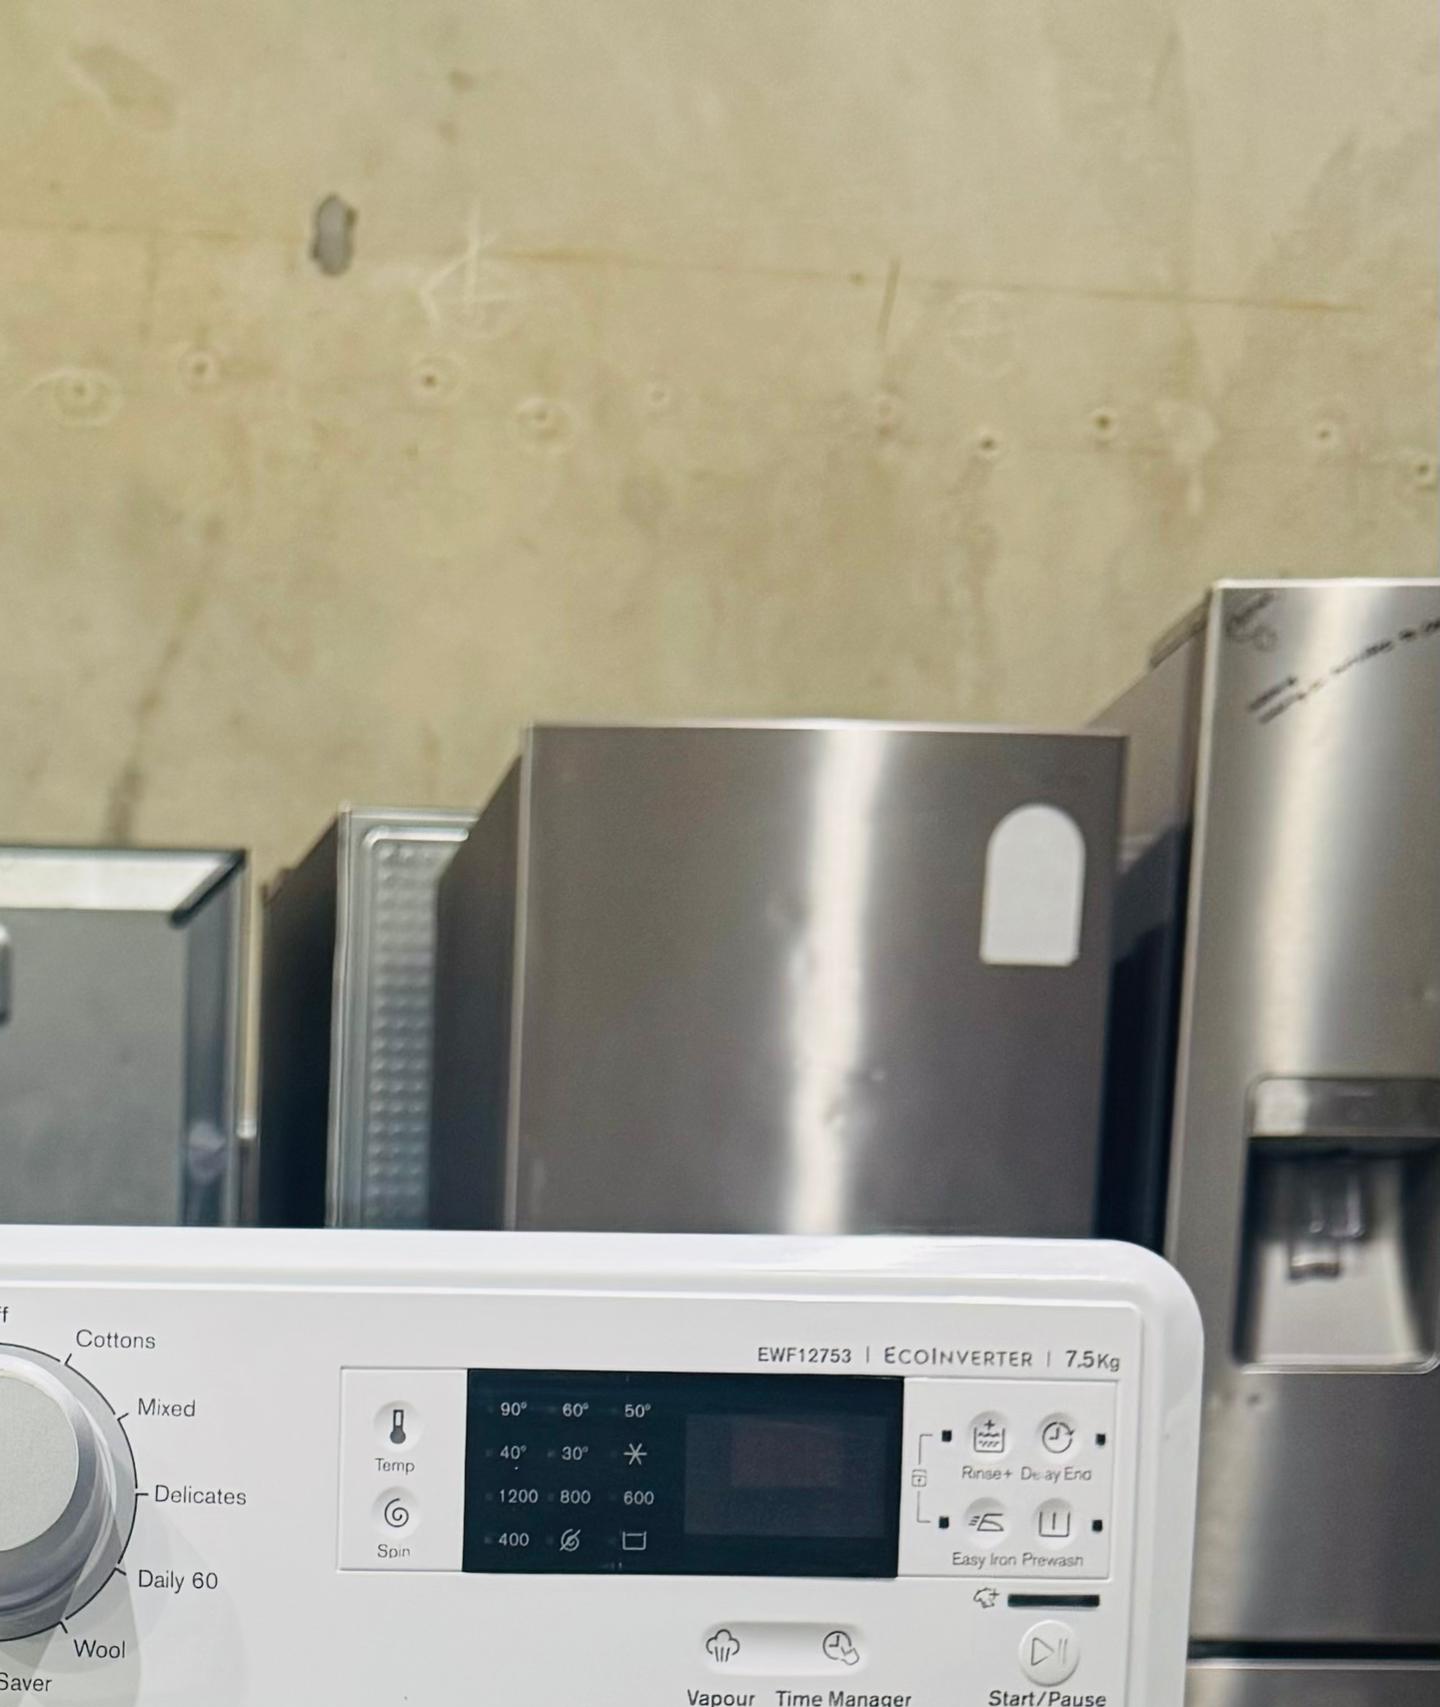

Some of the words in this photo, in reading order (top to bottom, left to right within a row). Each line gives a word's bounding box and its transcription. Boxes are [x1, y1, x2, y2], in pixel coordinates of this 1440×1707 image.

[75, 1329, 157, 1350] Cottons
[757, 1346, 852, 1364] EWF12753
[137, 1398, 197, 1418] Mixed
[375, 1458, 415, 1475] Temp
[1021, 1466, 1060, 1484] Deay
[154, 1484, 247, 1506] Delicates
[499, 1489, 538, 1504] 1200
[560, 1490, 591, 1504] 800
[624, 1491, 654, 1505] 600
[498, 1532, 530, 1547] 400
[377, 1543, 411, 1559] Spin
[952, 1552, 986, 1570] Easy
[990, 1552, 1017, 1566] Iron
[137, 1570, 185, 1594] Daily
[192, 1571, 218, 1590] 60
[74, 1639, 126, 1659] Wool
[775, 1690, 822, 1707] Time
